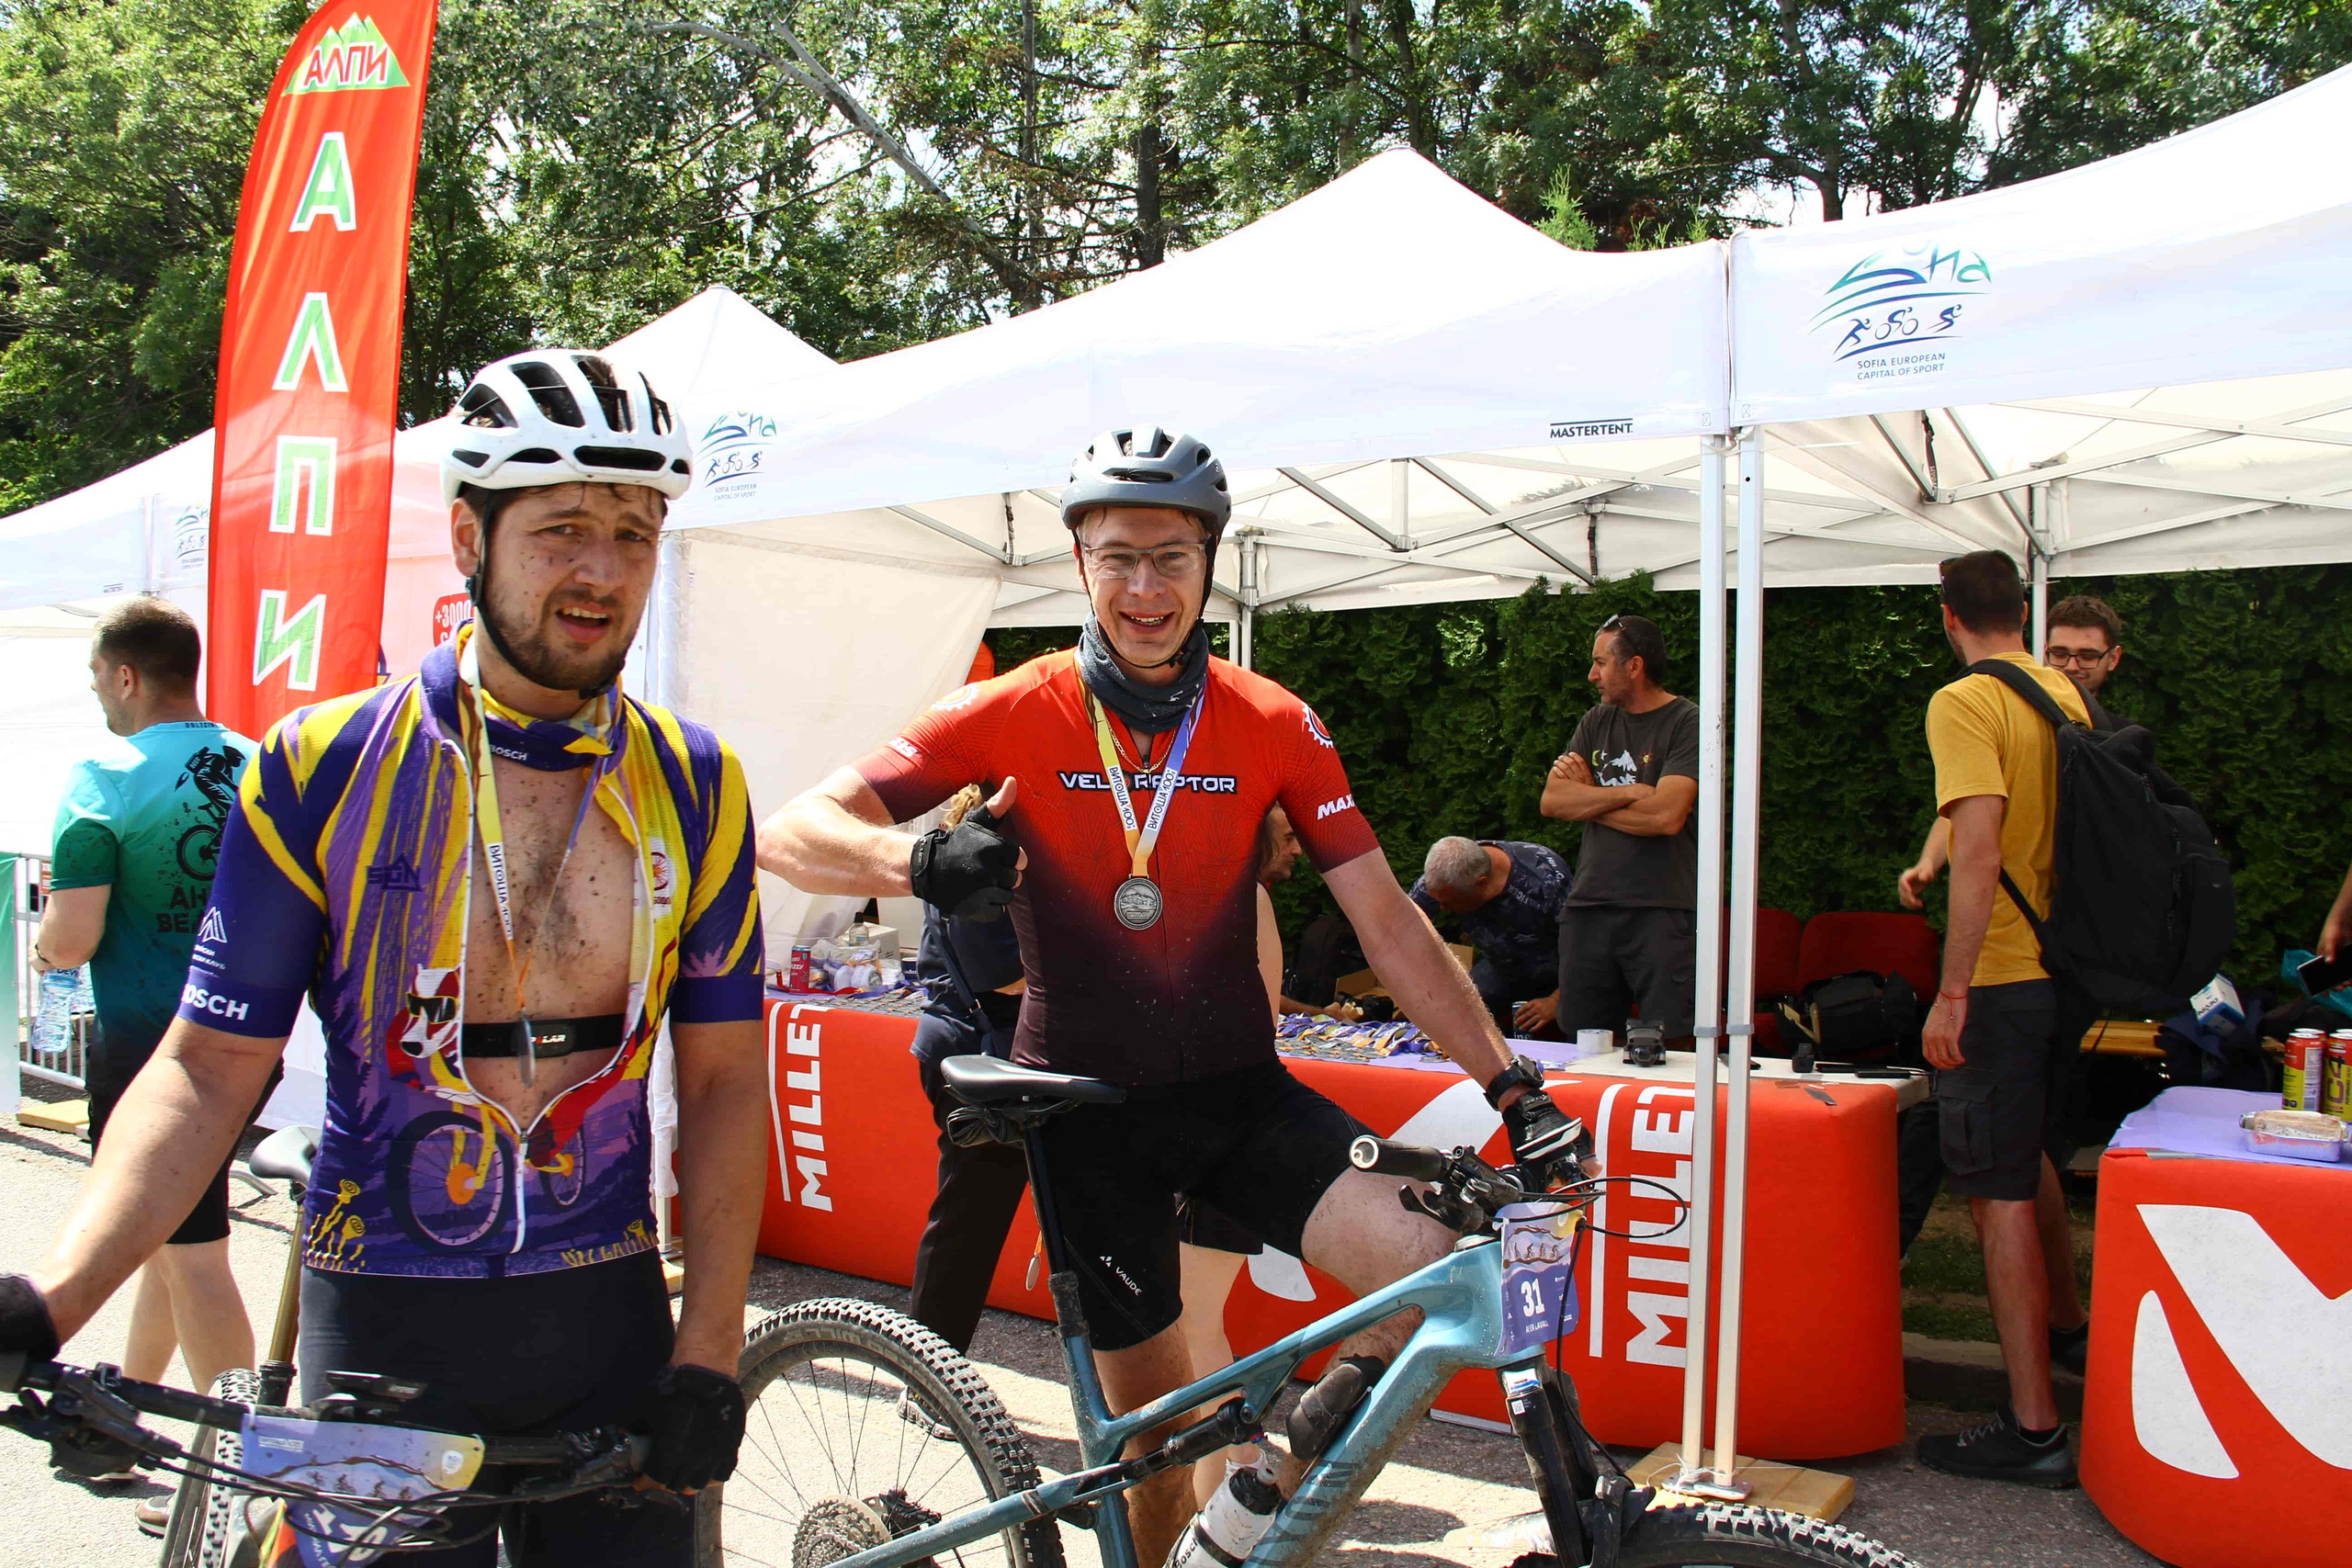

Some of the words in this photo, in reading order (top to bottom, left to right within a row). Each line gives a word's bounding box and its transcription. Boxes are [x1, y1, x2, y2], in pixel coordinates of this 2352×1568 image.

[302, 42, 390, 89] АЛПИ
[1857, 358, 1886, 369] SOFIA
[1891, 352, 1946, 366] EUROPEAN
[1857, 369, 1895, 380] CAPITAL
[1898, 367, 1910, 376] OF
[1913, 363, 1944, 375] SPORT
[252, 130, 357, 691] АЛПИ
[1549, 423, 1633, 438] MASTERTENT
[730, 483, 757, 491] EUROPEAN
[1109, 766, 1129, 807] ВИТОША
[1148, 790, 1168, 829] ВИТОША
[182, 983, 250, 1021] OSCH
[1115, 1266, 1142, 1296] VAUDE
[1520, 1278, 1545, 1317] 31
